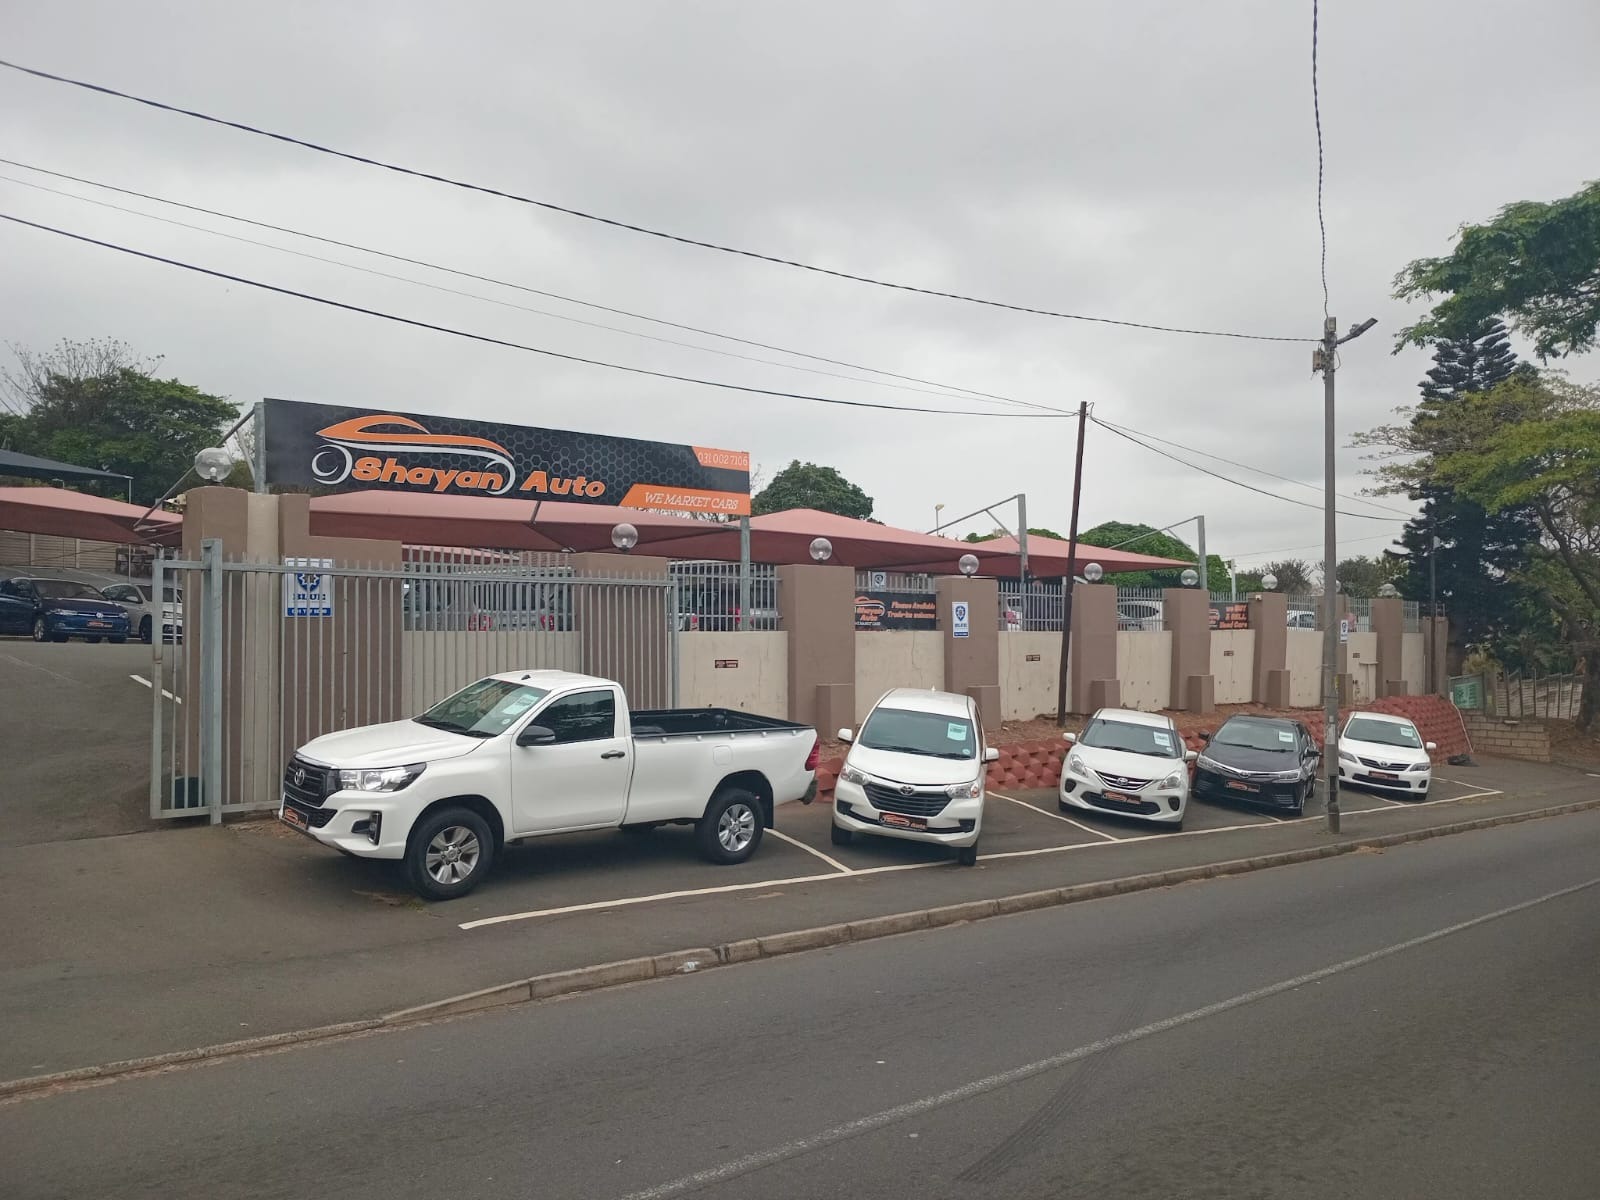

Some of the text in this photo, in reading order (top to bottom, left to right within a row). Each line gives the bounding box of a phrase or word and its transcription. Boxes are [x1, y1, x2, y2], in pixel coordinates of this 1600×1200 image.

[697, 452, 748, 466] 031 002 7106
[351, 456, 606, 498] Shayan Auto
[644, 492, 739, 510] WE MARKET CARS
